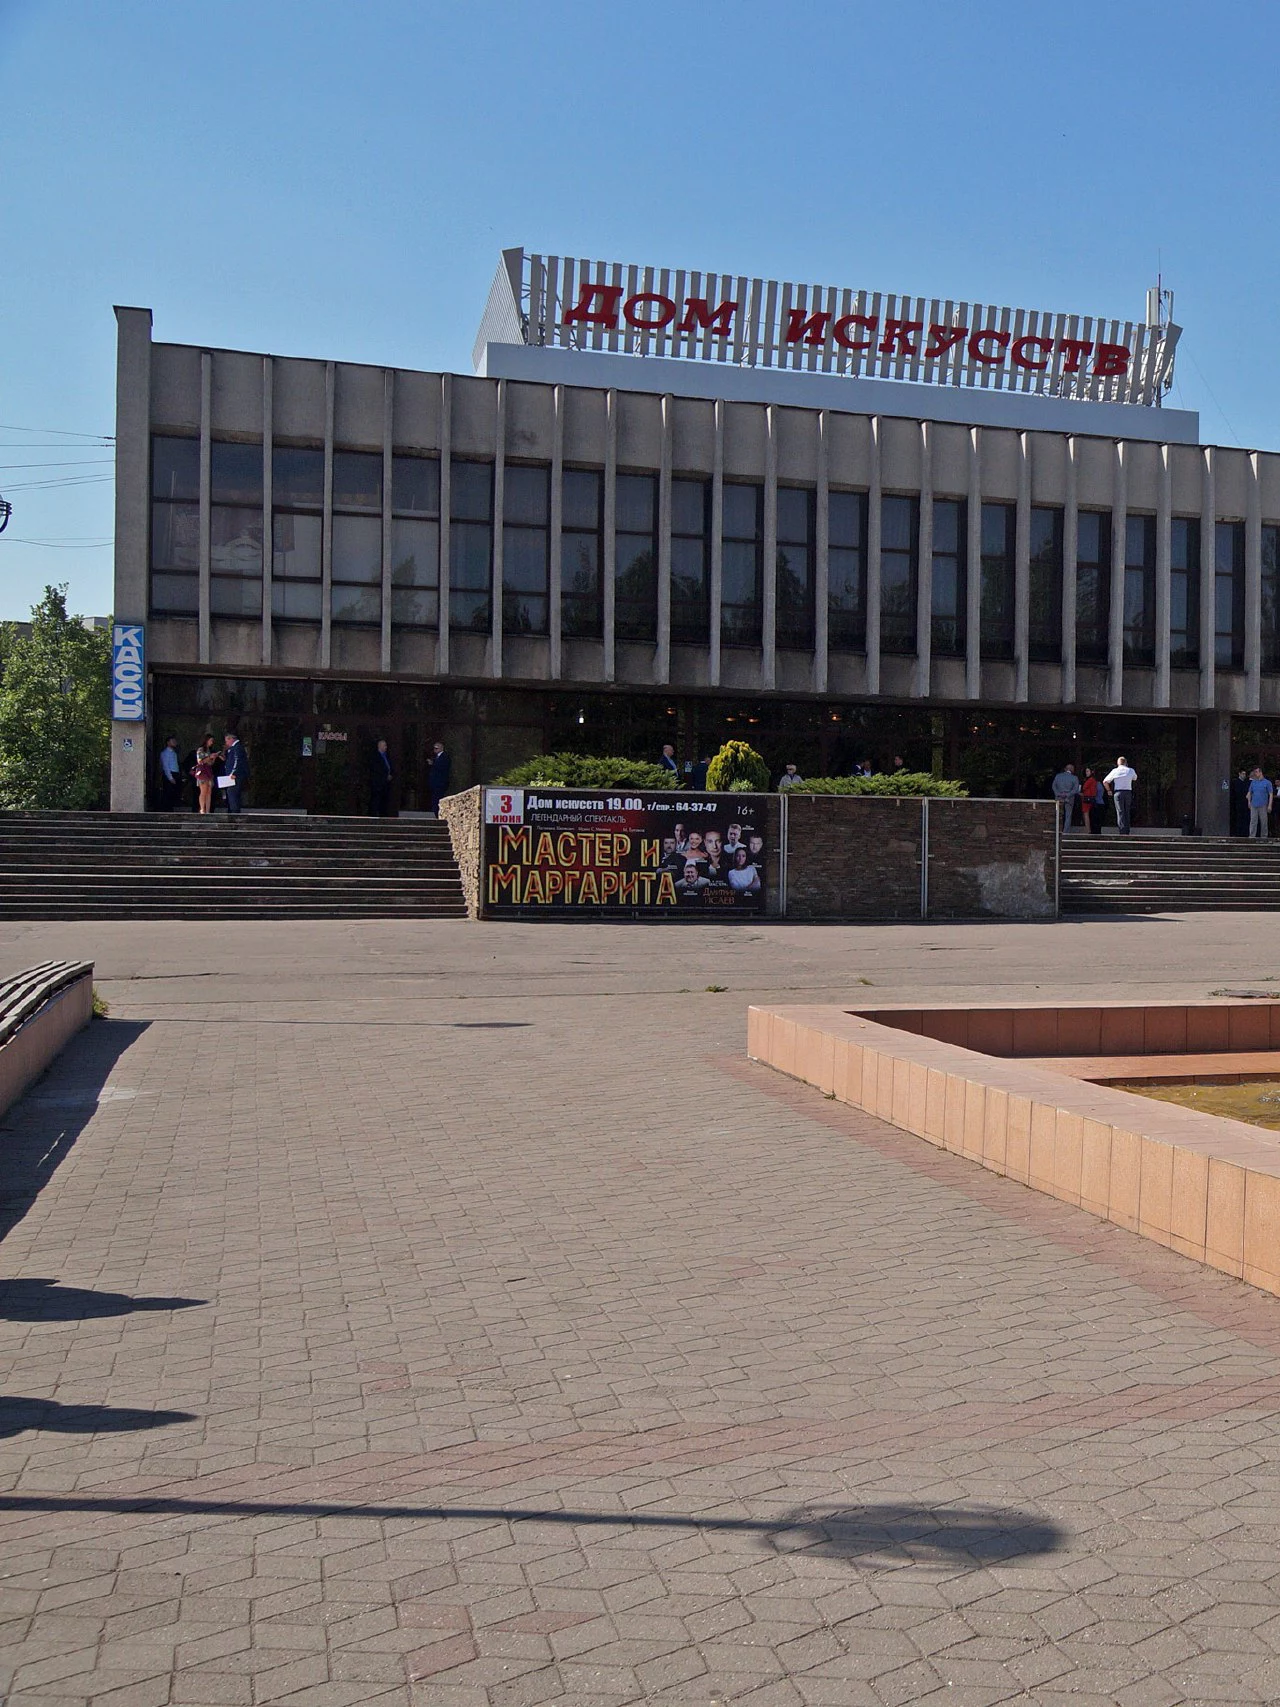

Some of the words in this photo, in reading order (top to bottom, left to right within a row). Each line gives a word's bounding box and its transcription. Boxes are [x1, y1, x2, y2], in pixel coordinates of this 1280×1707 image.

[564, 283, 739, 337] ДОМ
[785, 308, 1132, 376] ИСКУССТВ
[114, 628, 142, 718] КАССЫ
[319, 731, 347, 741] КАССЫ
[500, 795, 512, 814] 3
[527, 795, 553, 810] Дом
[556, 799, 604, 810] искусств
[676, 802, 717, 812] 64-37-47
[737, 806, 755, 815] 16+
[493, 815, 521, 823] ИЮНЯ
[531, 813, 582, 823] ЛЕГЕНДАРНЫЙ
[584, 814, 626, 824] СПЕКТАКЛЬ
[499, 825, 631, 867] МАСТЕР
[488, 864, 677, 905] МАРГАРИТА
